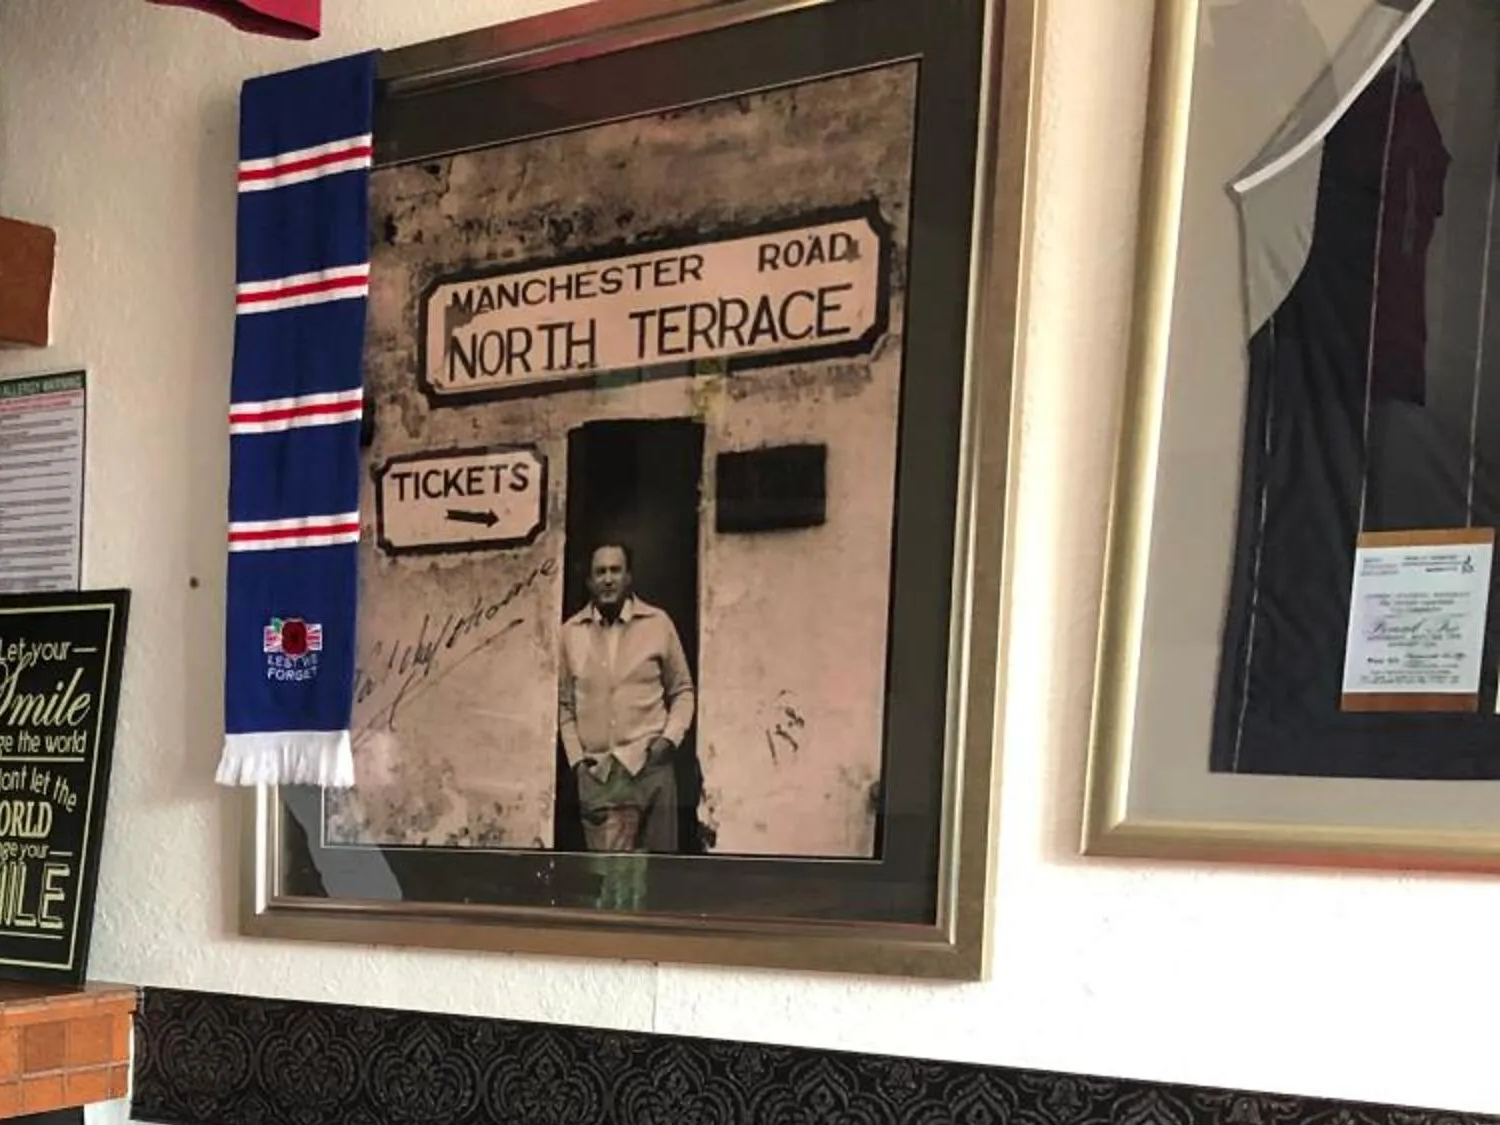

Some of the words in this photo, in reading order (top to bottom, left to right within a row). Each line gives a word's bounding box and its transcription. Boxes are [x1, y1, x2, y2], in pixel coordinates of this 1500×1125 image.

[450, 253, 705, 314] MANCHESTER
[757, 232, 855, 273] ROAD
[448, 318, 597, 383] NORTH
[628, 283, 853, 360] TERRACE
[389, 460, 531, 502] TICKETS
[29, 640, 73, 667] your
[267, 665, 318, 681] FORGET
[17, 729, 41, 753] the
[45, 729, 88, 754] world
[29, 765, 52, 796] let
[52, 775, 78, 812] the
[19, 843, 50, 861] your
